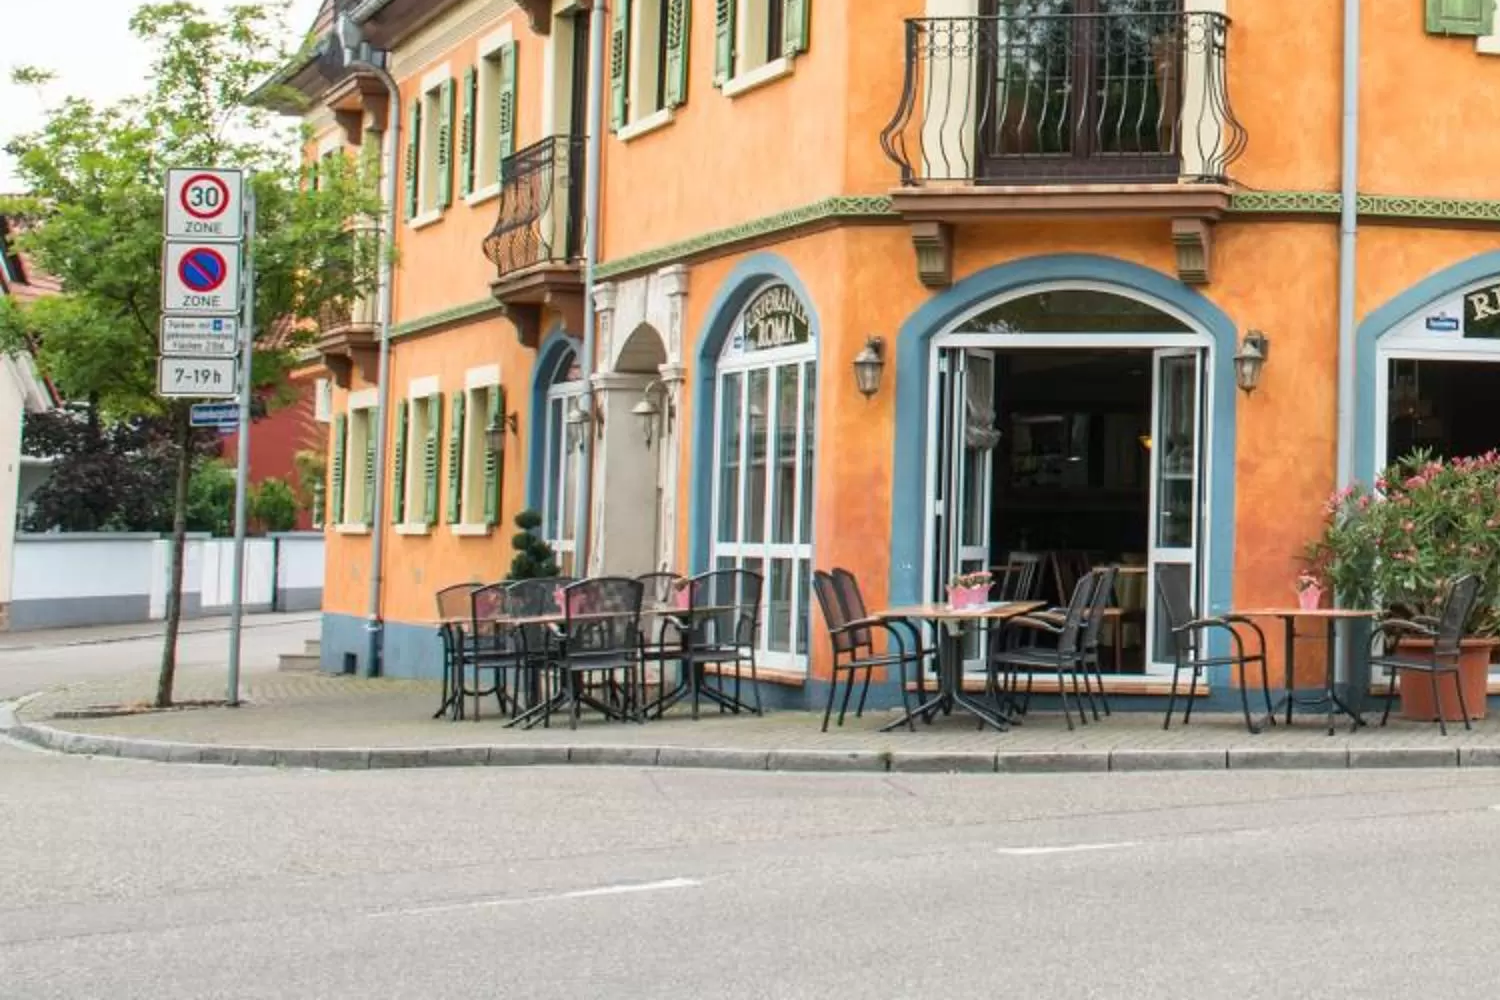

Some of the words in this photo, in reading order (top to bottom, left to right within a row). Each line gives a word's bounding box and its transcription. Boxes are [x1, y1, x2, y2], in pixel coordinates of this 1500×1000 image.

[191, 186, 219, 207] 30
[184, 221, 223, 233] ZONE
[182, 295, 221, 307] ZONE
[757, 314, 797, 348] ROMA
